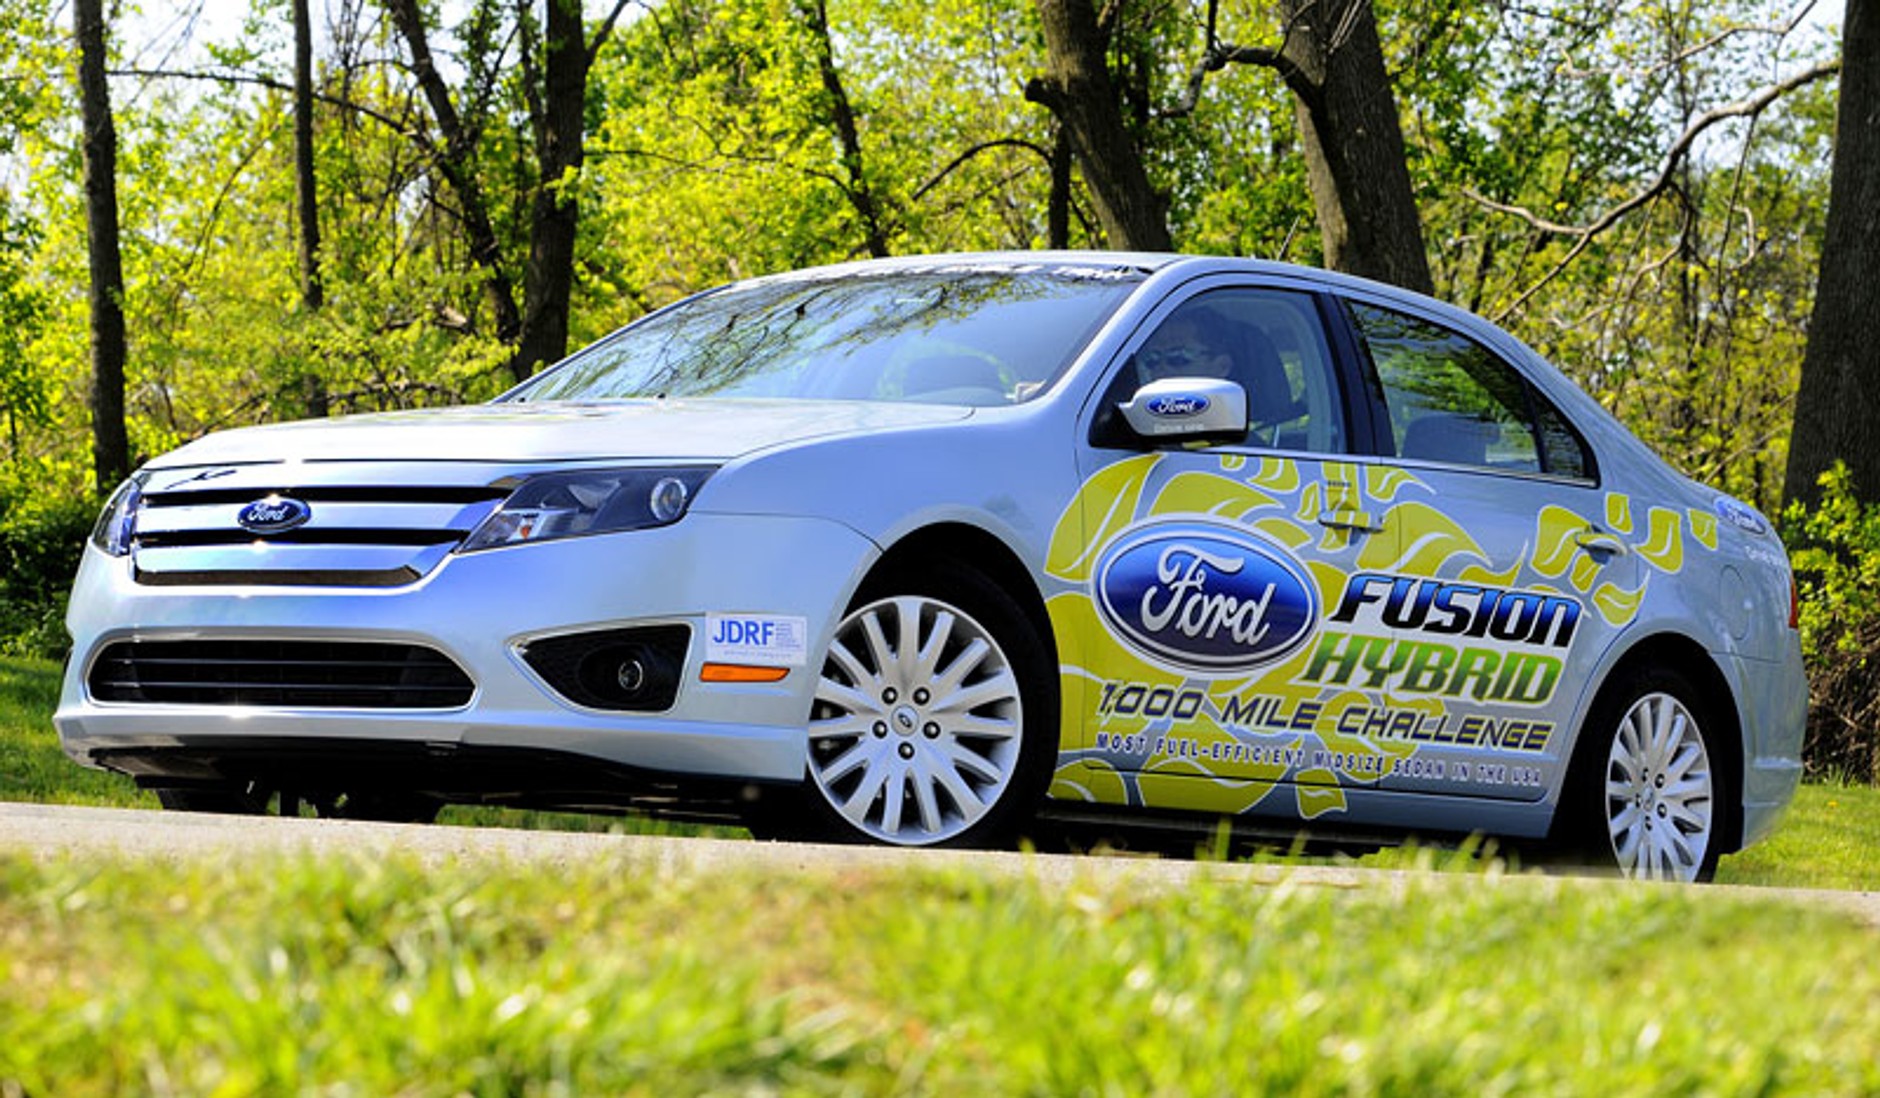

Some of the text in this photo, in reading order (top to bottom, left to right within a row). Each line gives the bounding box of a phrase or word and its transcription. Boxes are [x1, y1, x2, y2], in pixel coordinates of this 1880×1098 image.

[247, 501, 290, 521] Ford
[1141, 543, 1277, 646] Ford
[1328, 573, 1582, 648] FUSION
[712, 620, 774, 645] JDRF
[1300, 631, 1563, 702] HYBRID
[1221, 695, 1323, 730] MILE
[1337, 706, 1554, 751] CHALLENGE
[1097, 734, 1146, 754] MOST
[1155, 739, 1303, 767] FUEL-EFFICIENT
[1312, 752, 1385, 774] MIDSIZE
